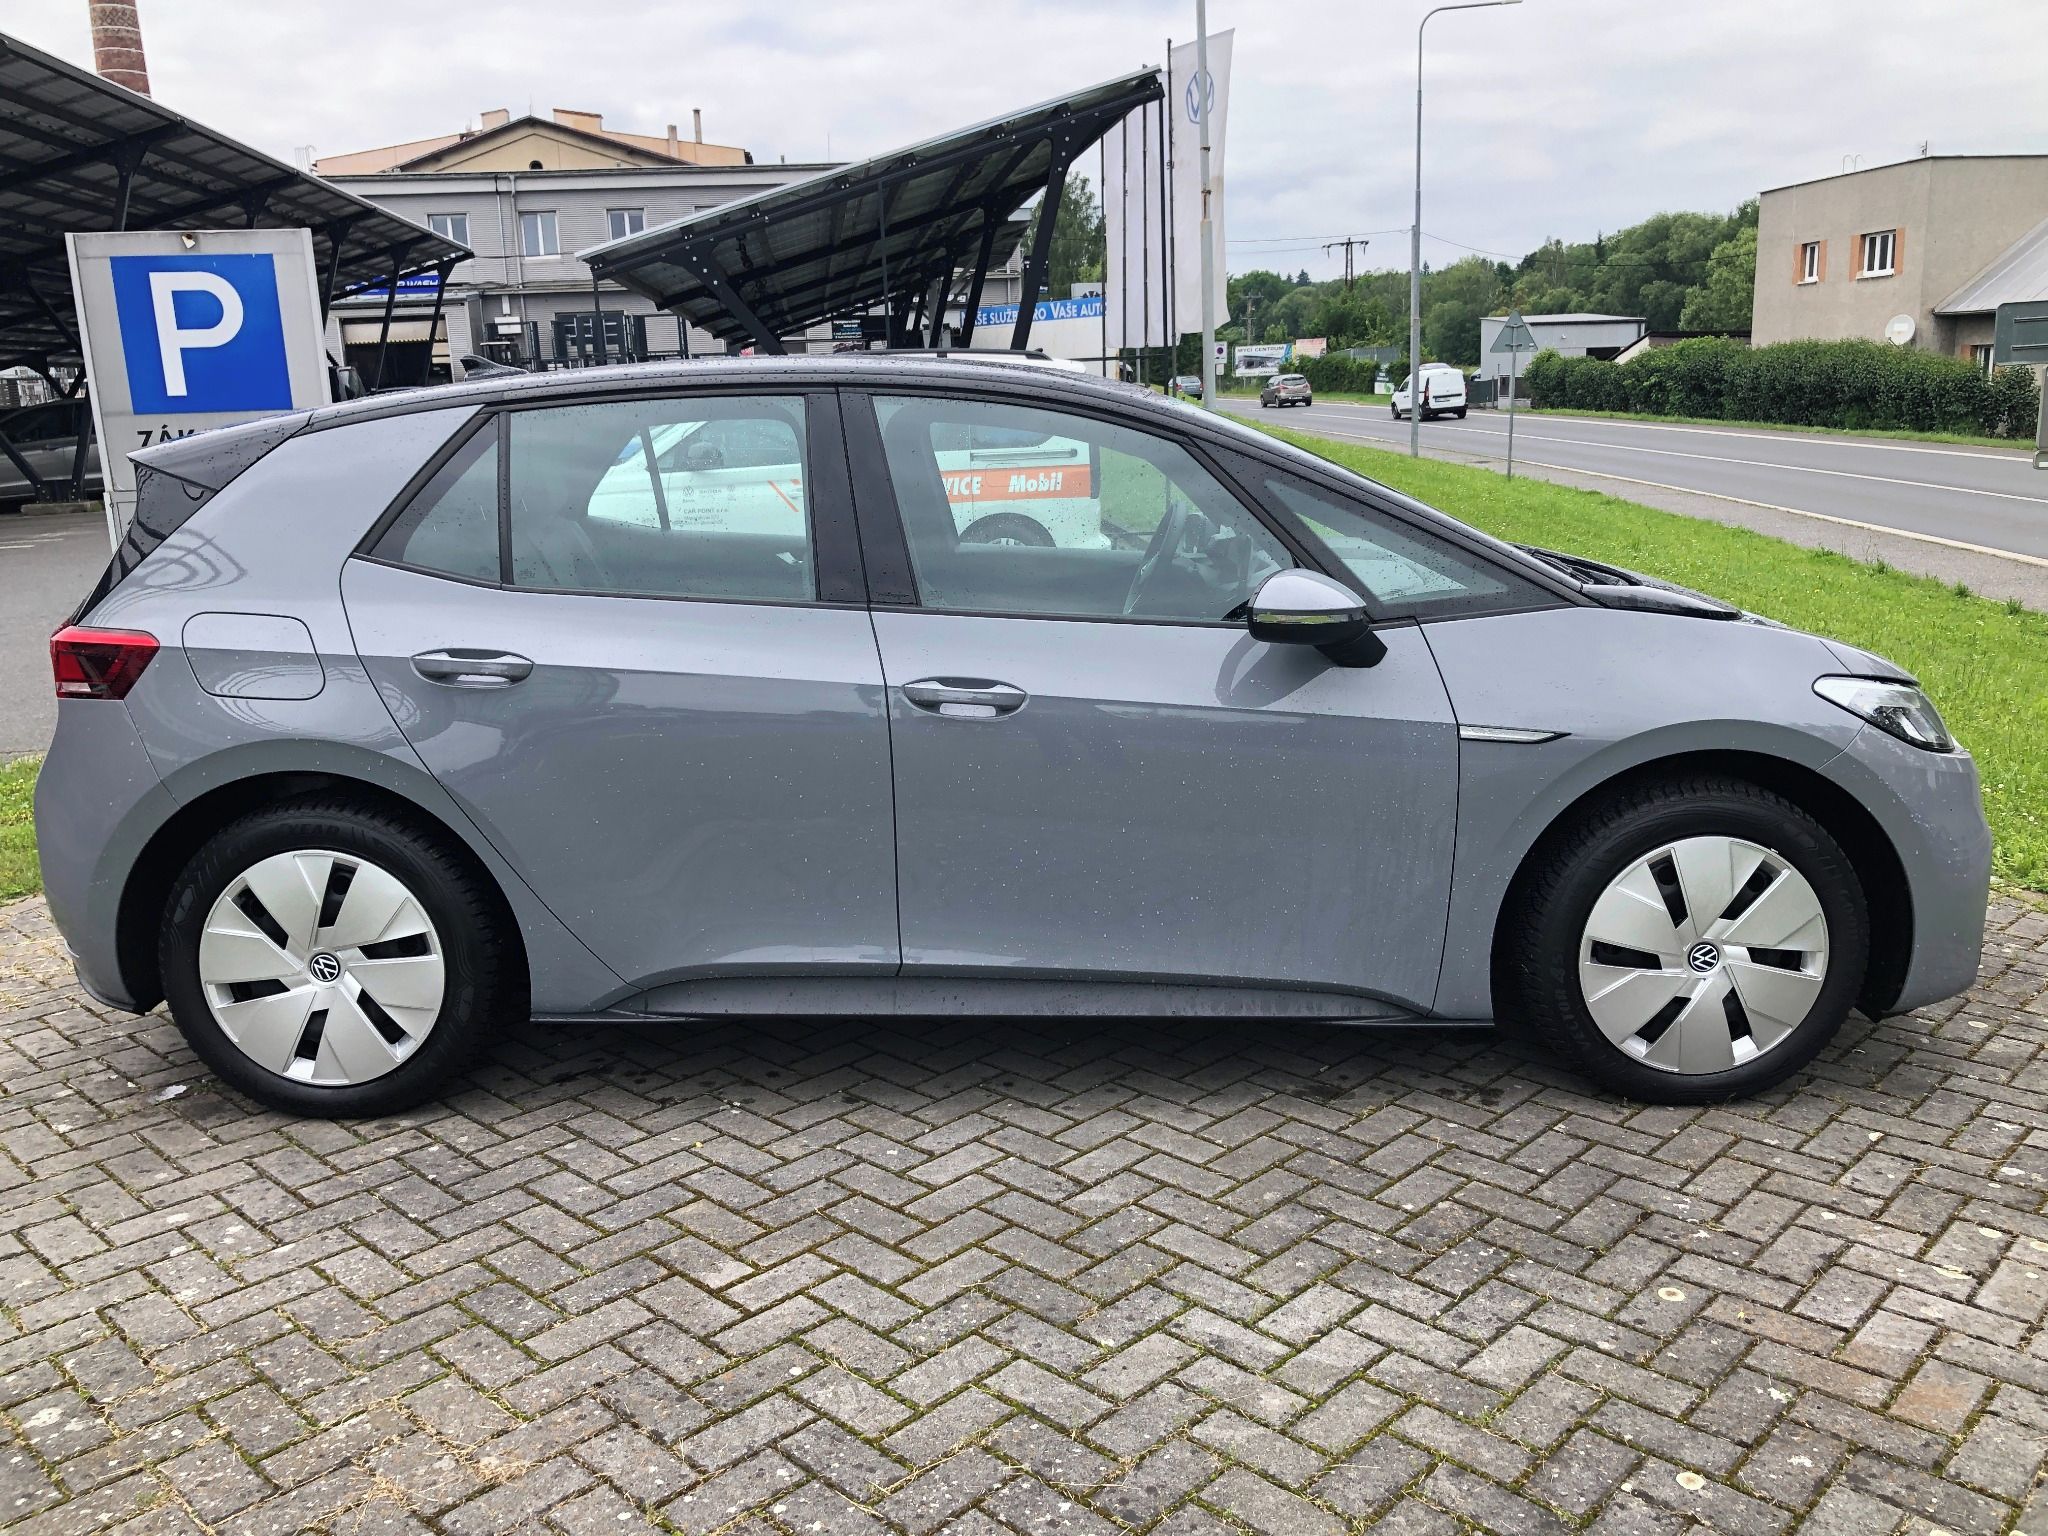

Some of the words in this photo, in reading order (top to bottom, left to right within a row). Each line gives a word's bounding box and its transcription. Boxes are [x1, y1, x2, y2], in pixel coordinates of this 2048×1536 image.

[961, 311, 987, 325] NŠE
[990, 308, 1018, 324] SLUŽB
[1033, 308, 1046, 320] RO
[1081, 303, 1105, 316] AUT
[148, 271, 244, 397] P
[943, 476, 982, 496] VICE
[1008, 472, 1063, 493] Mobil
